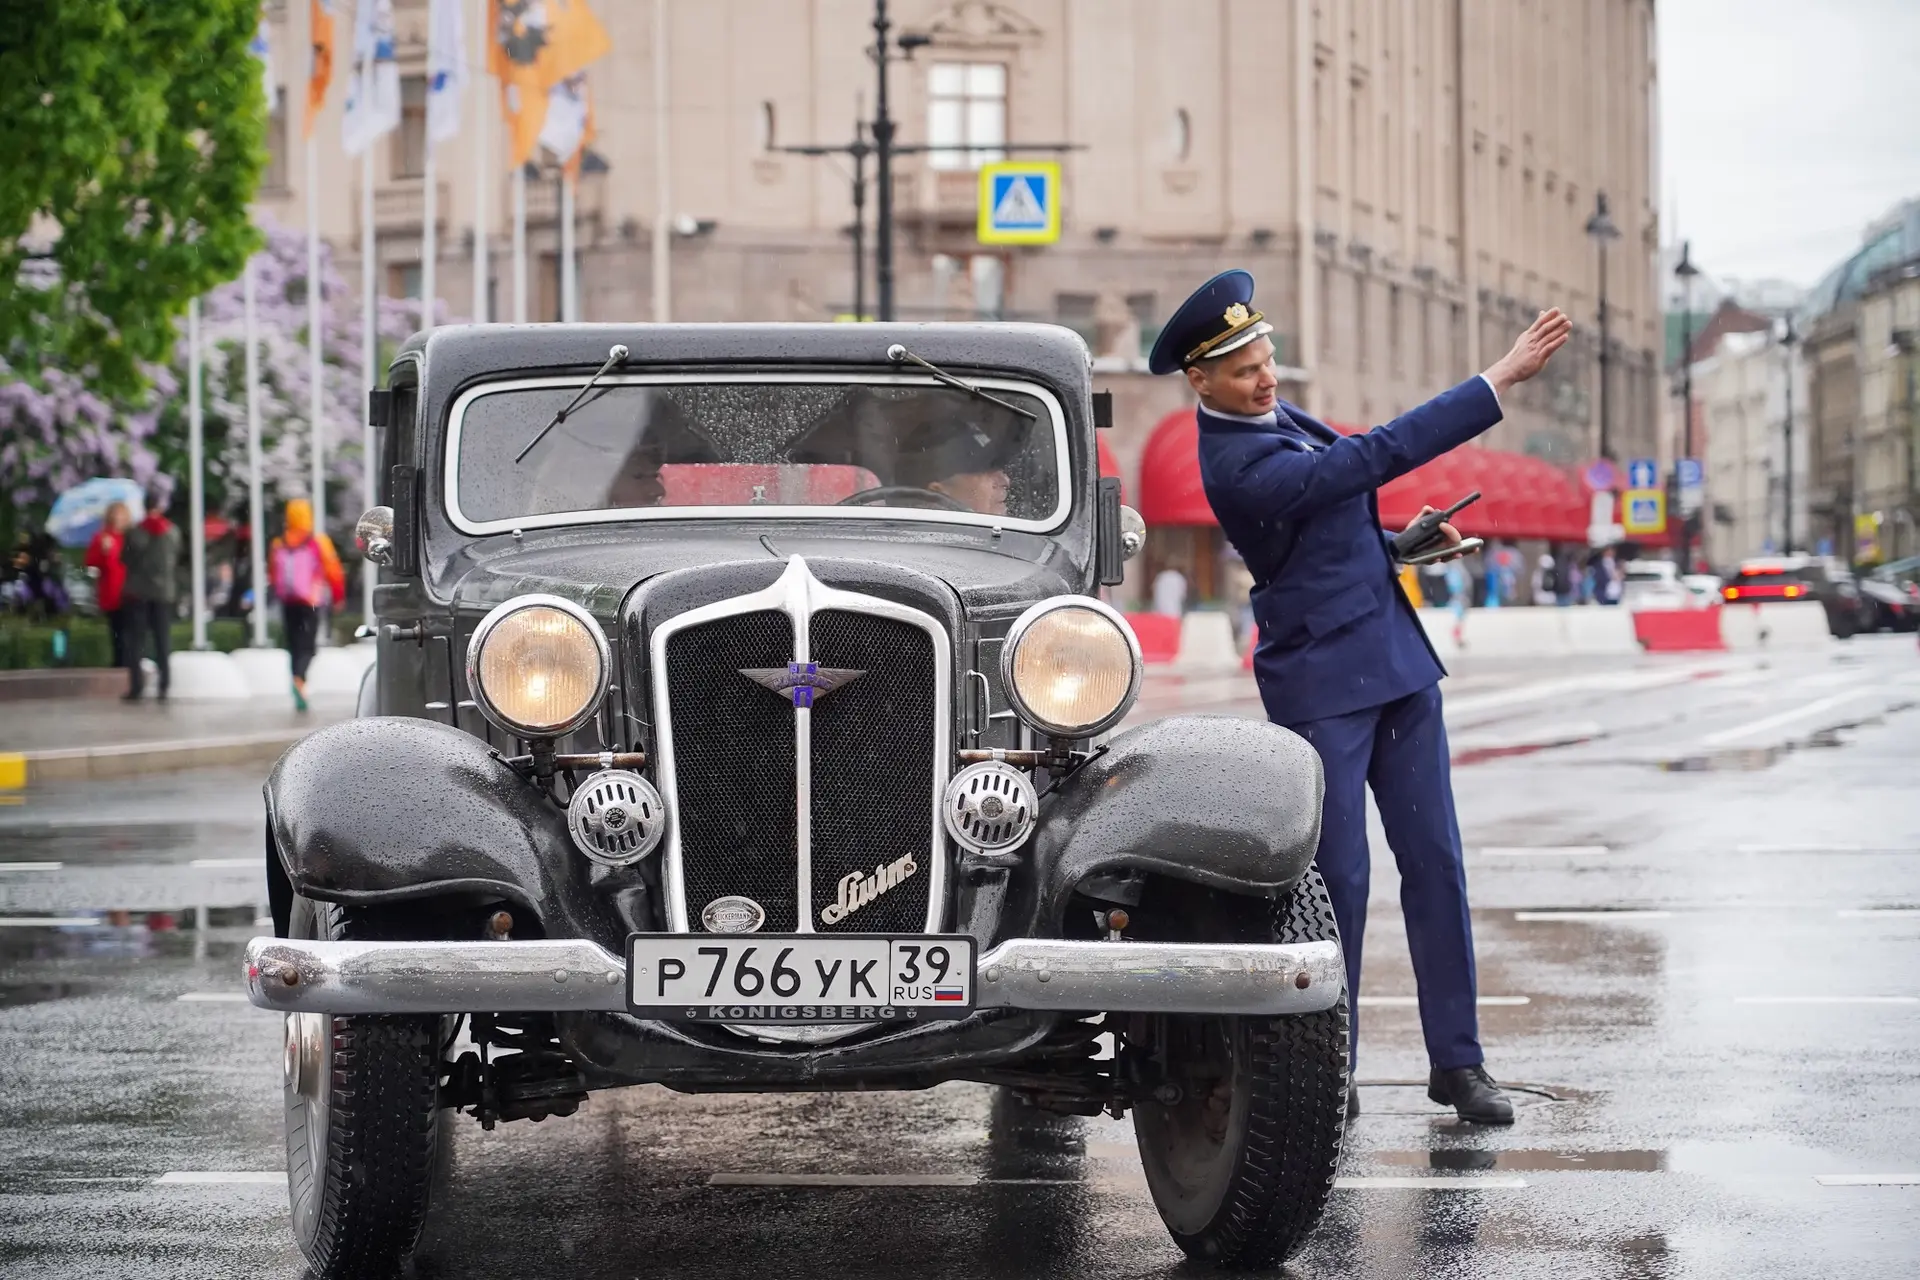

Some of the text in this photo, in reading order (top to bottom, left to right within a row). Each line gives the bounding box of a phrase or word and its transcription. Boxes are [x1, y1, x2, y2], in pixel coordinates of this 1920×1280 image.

[822, 852, 917, 924] Sturm
[898, 946, 951, 984] 39
[894, 986, 932, 1000] RUS
